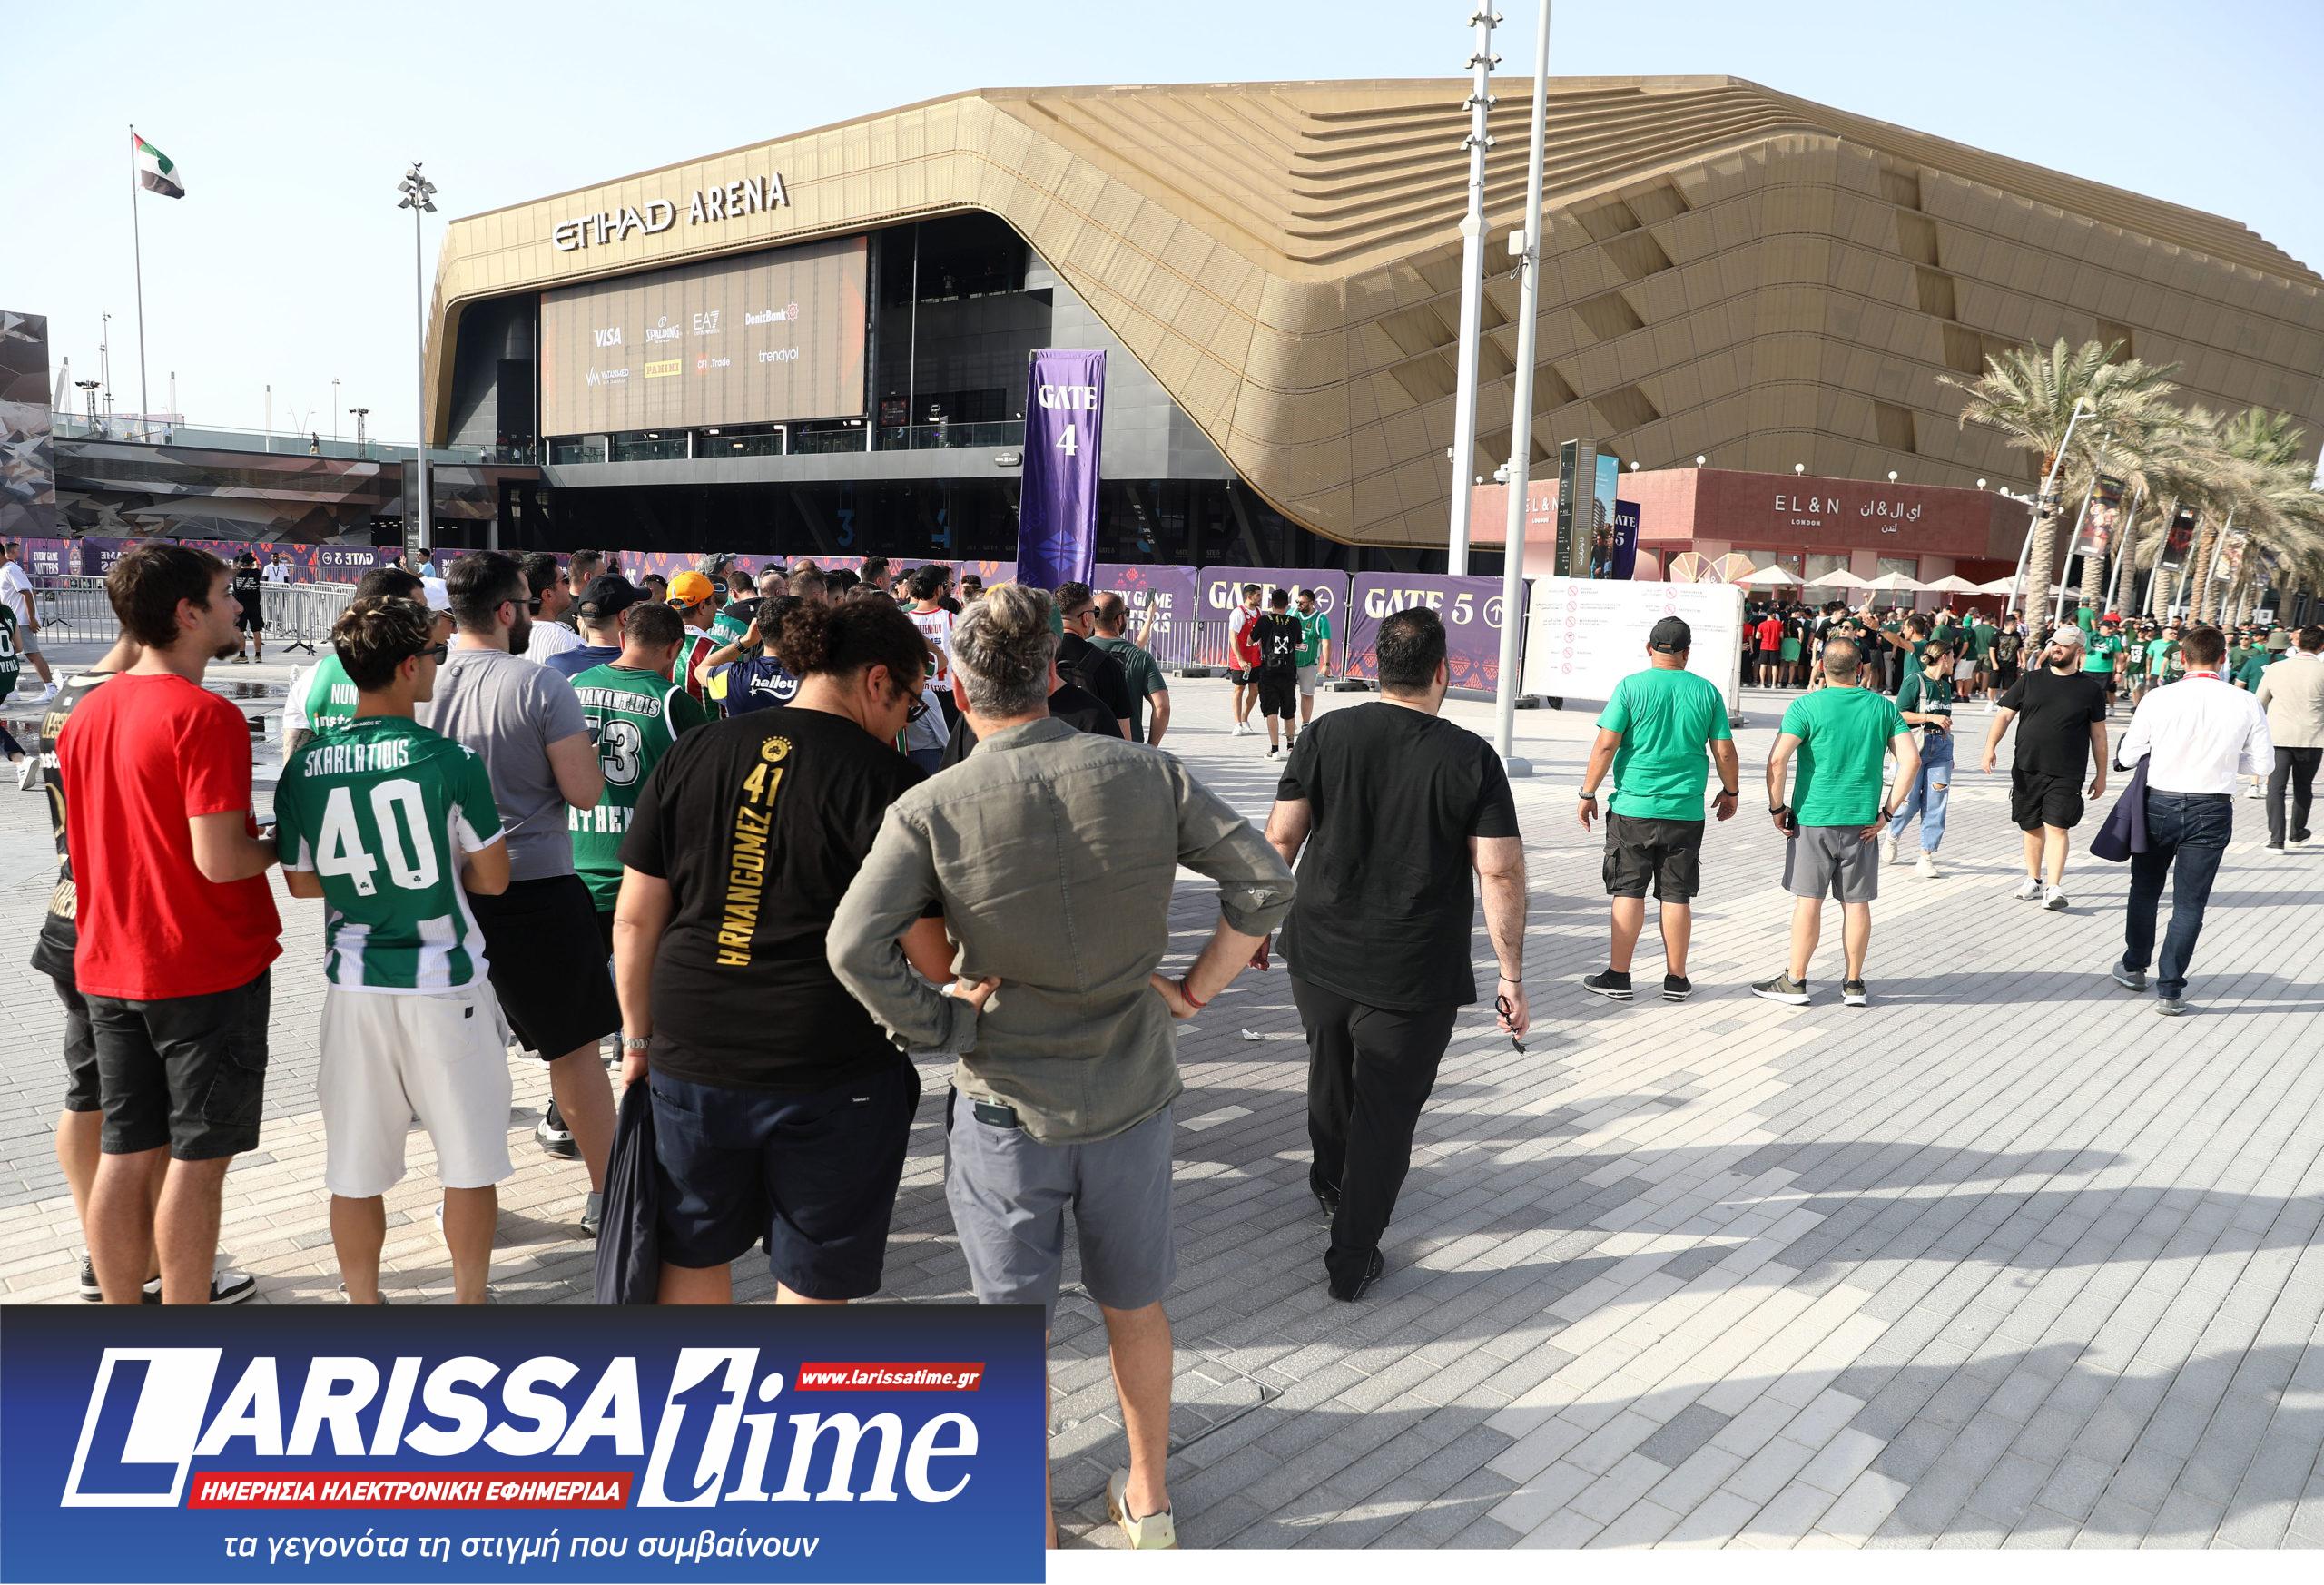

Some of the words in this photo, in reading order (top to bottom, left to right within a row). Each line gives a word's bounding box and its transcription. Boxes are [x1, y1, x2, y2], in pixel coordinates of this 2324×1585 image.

[552, 199, 675, 251] ETIHAD
[688, 172, 788, 224] ARENA
[745, 308, 786, 326] DenizBank
[593, 327, 621, 347] VISA
[645, 324, 680, 342] SPALDING
[758, 346, 799, 363] trendyol
[645, 363, 680, 375] PANINI
[1038, 384, 1098, 410] GATE
[1055, 423, 1078, 456] 4
[837, 508, 854, 546] 3
[1615, 514, 1636, 527] ATE
[1791, 518, 1821, 527] LONDON
[1615, 531, 1625, 546] 5
[34, 562, 59, 575] MATTERS
[1132, 590, 1173, 609] GME
[1451, 593, 1474, 625] 5
[330, 684, 359, 705] NUN
[750, 674, 798, 695] halley
[304, 739, 409, 778] SKARLATIDIS
[743, 763, 783, 808] 41
[568, 804, 635, 833] ATHEN
[316, 778, 440, 897] 40
